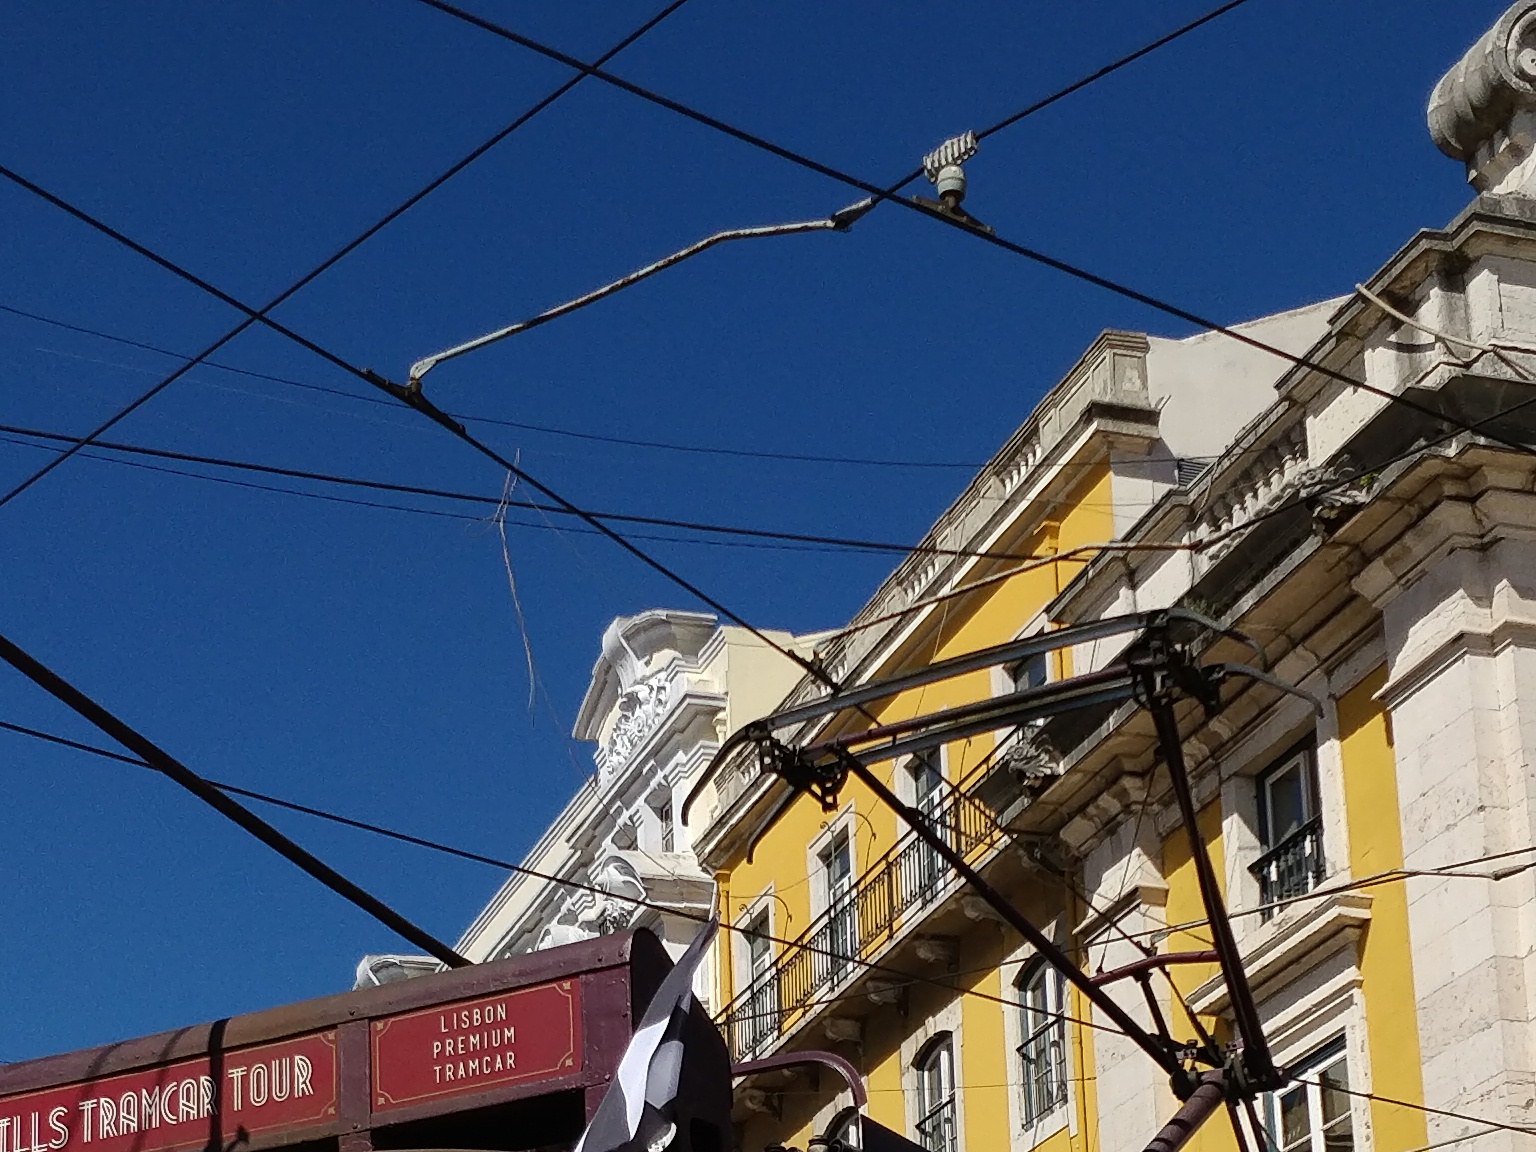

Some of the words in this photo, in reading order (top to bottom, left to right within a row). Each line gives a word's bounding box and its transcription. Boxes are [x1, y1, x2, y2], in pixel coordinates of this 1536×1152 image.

[440, 1003, 507, 1033] LISBON
[433, 1026, 515, 1059] PREMIUM
[433, 1052, 516, 1084] TRAMCAR
[78, 1075, 219, 1144] TRAMCAR
[227, 1054, 315, 1112] TOUR
